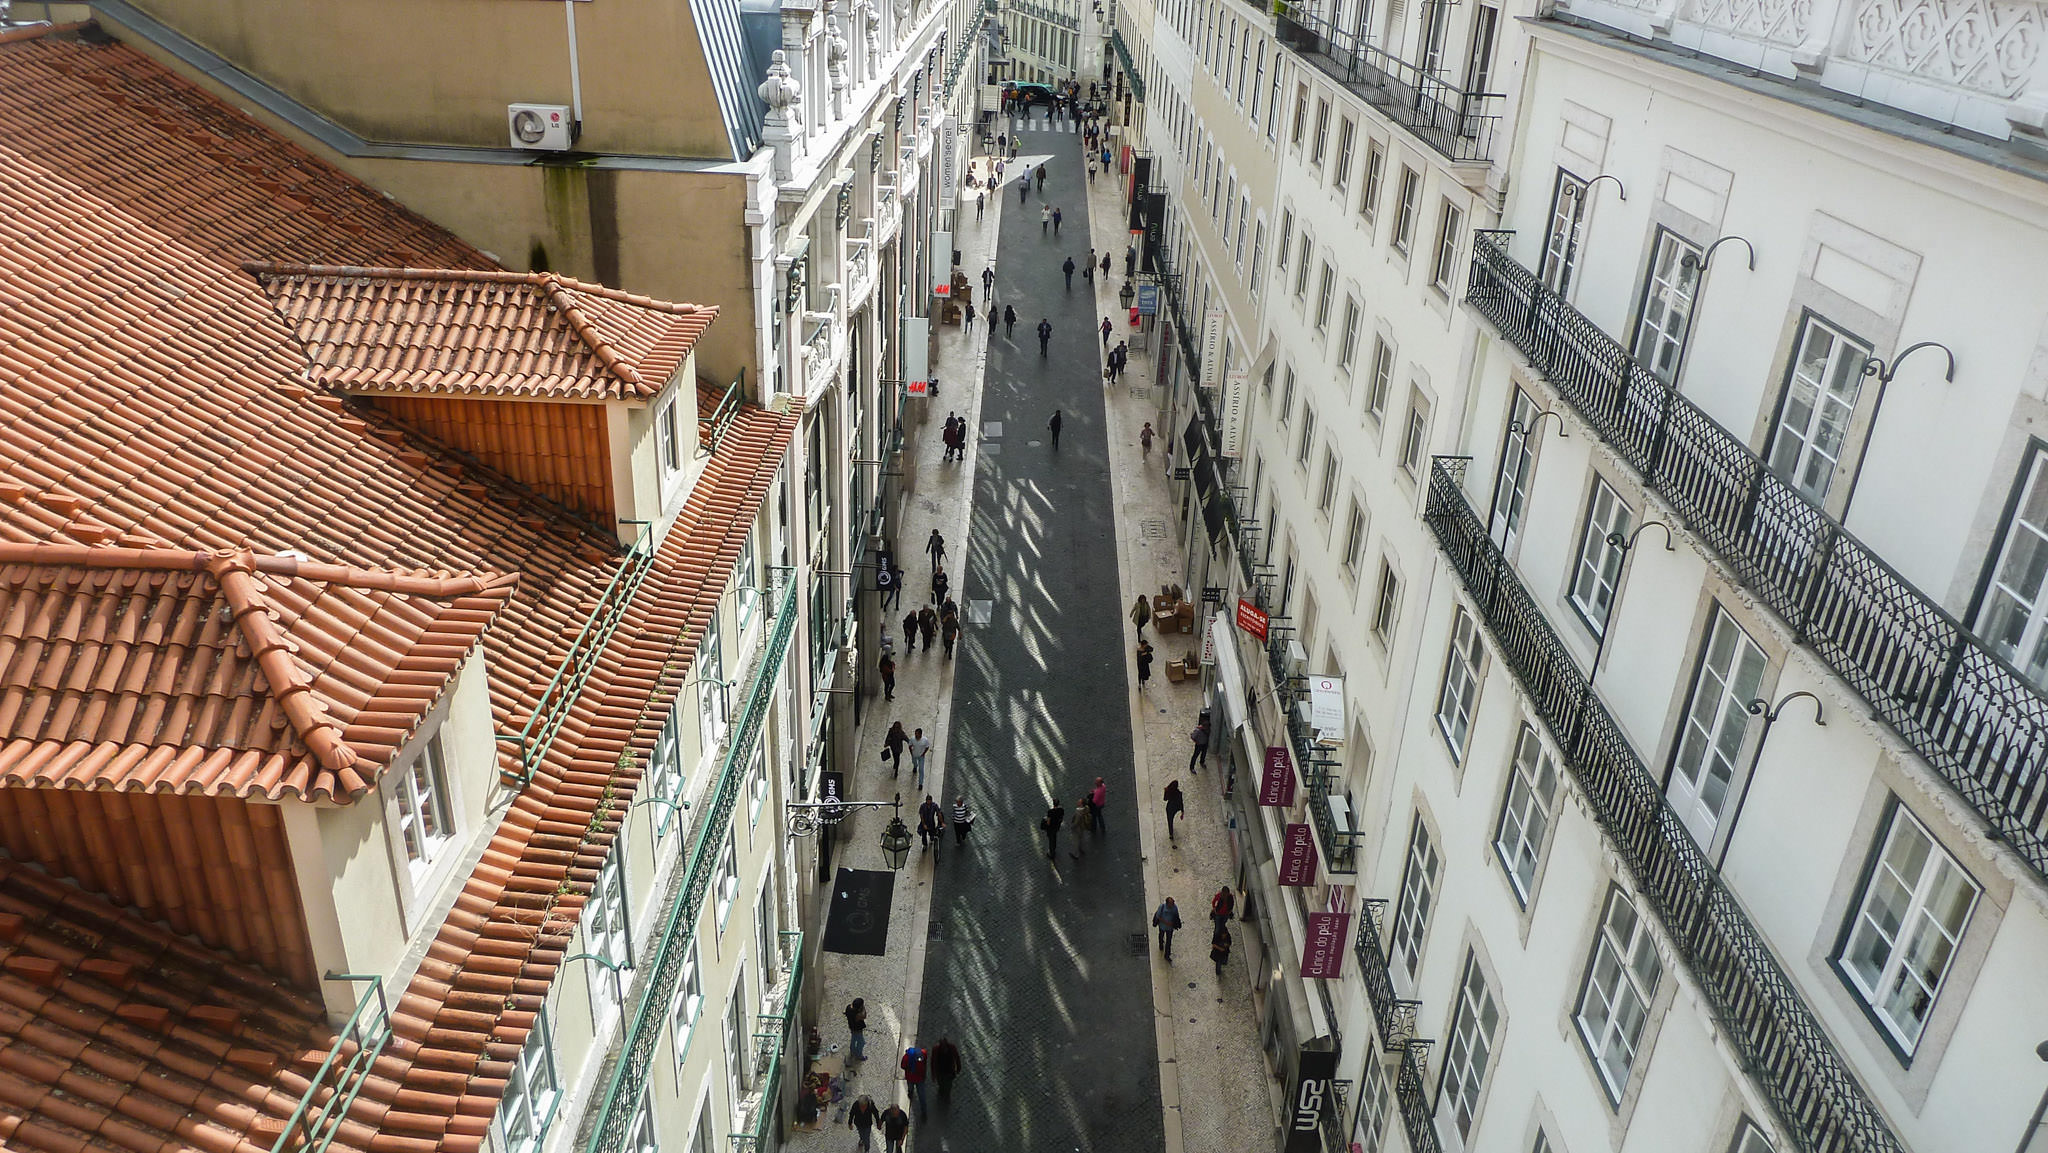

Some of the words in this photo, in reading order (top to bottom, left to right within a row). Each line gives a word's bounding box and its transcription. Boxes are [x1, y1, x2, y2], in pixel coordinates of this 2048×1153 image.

[1206, 359, 1214, 382] ALVIM
[1228, 425, 1237, 451] ALVIM
[1239, 604, 1266, 625] ALUGA-SE
[1269, 769, 1281, 778] do
[1290, 846, 1304, 857] do
[1314, 936, 1328, 947] do
